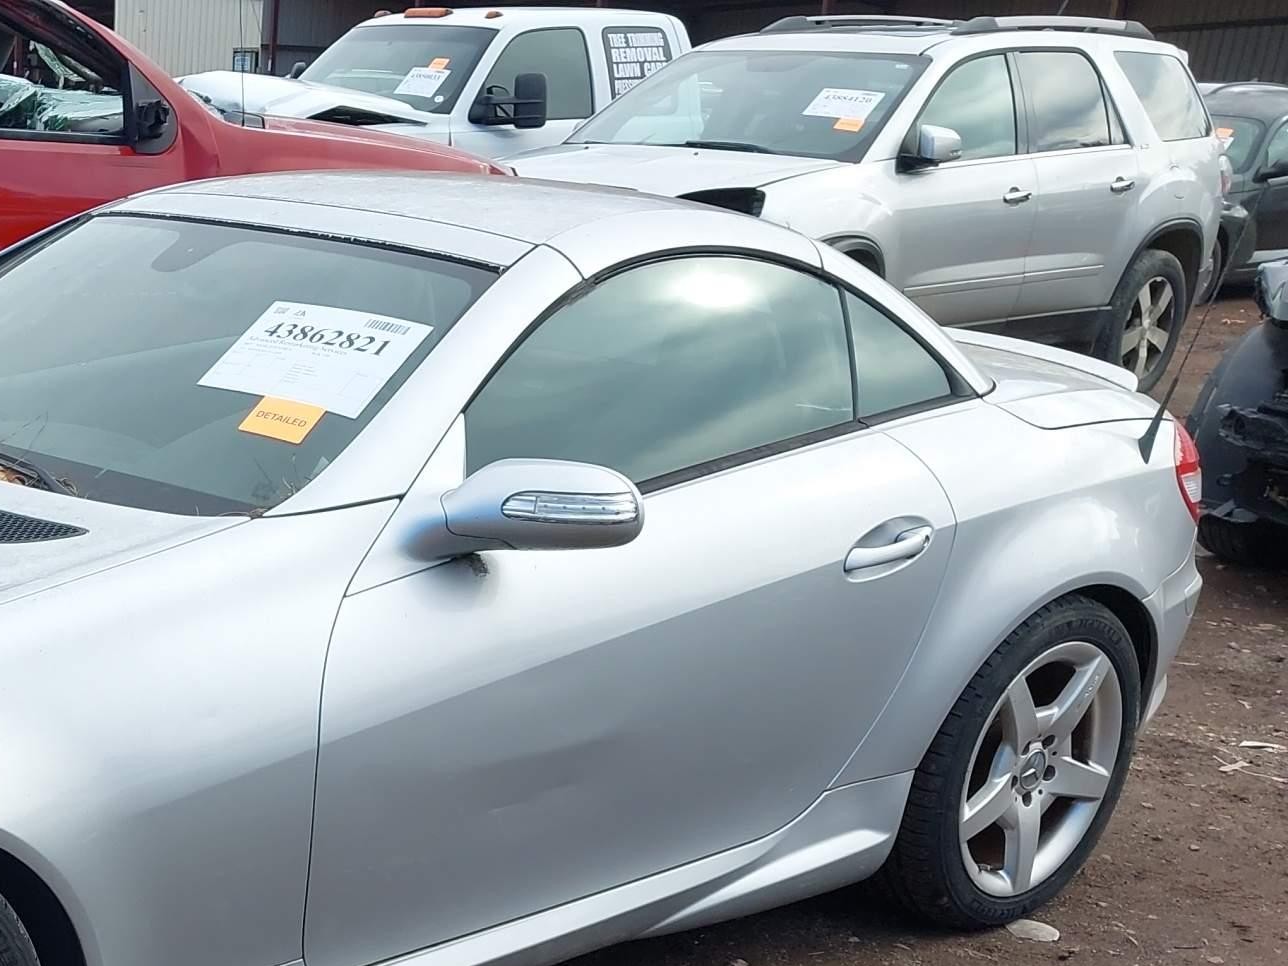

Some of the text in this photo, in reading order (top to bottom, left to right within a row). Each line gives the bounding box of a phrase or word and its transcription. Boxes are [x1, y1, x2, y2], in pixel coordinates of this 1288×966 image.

[612, 47, 666, 62] REMOVAL
[613, 63, 641, 78] LAWN
[265, 321, 391, 357] 43862821
[256, 410, 307, 428] DETAILED
